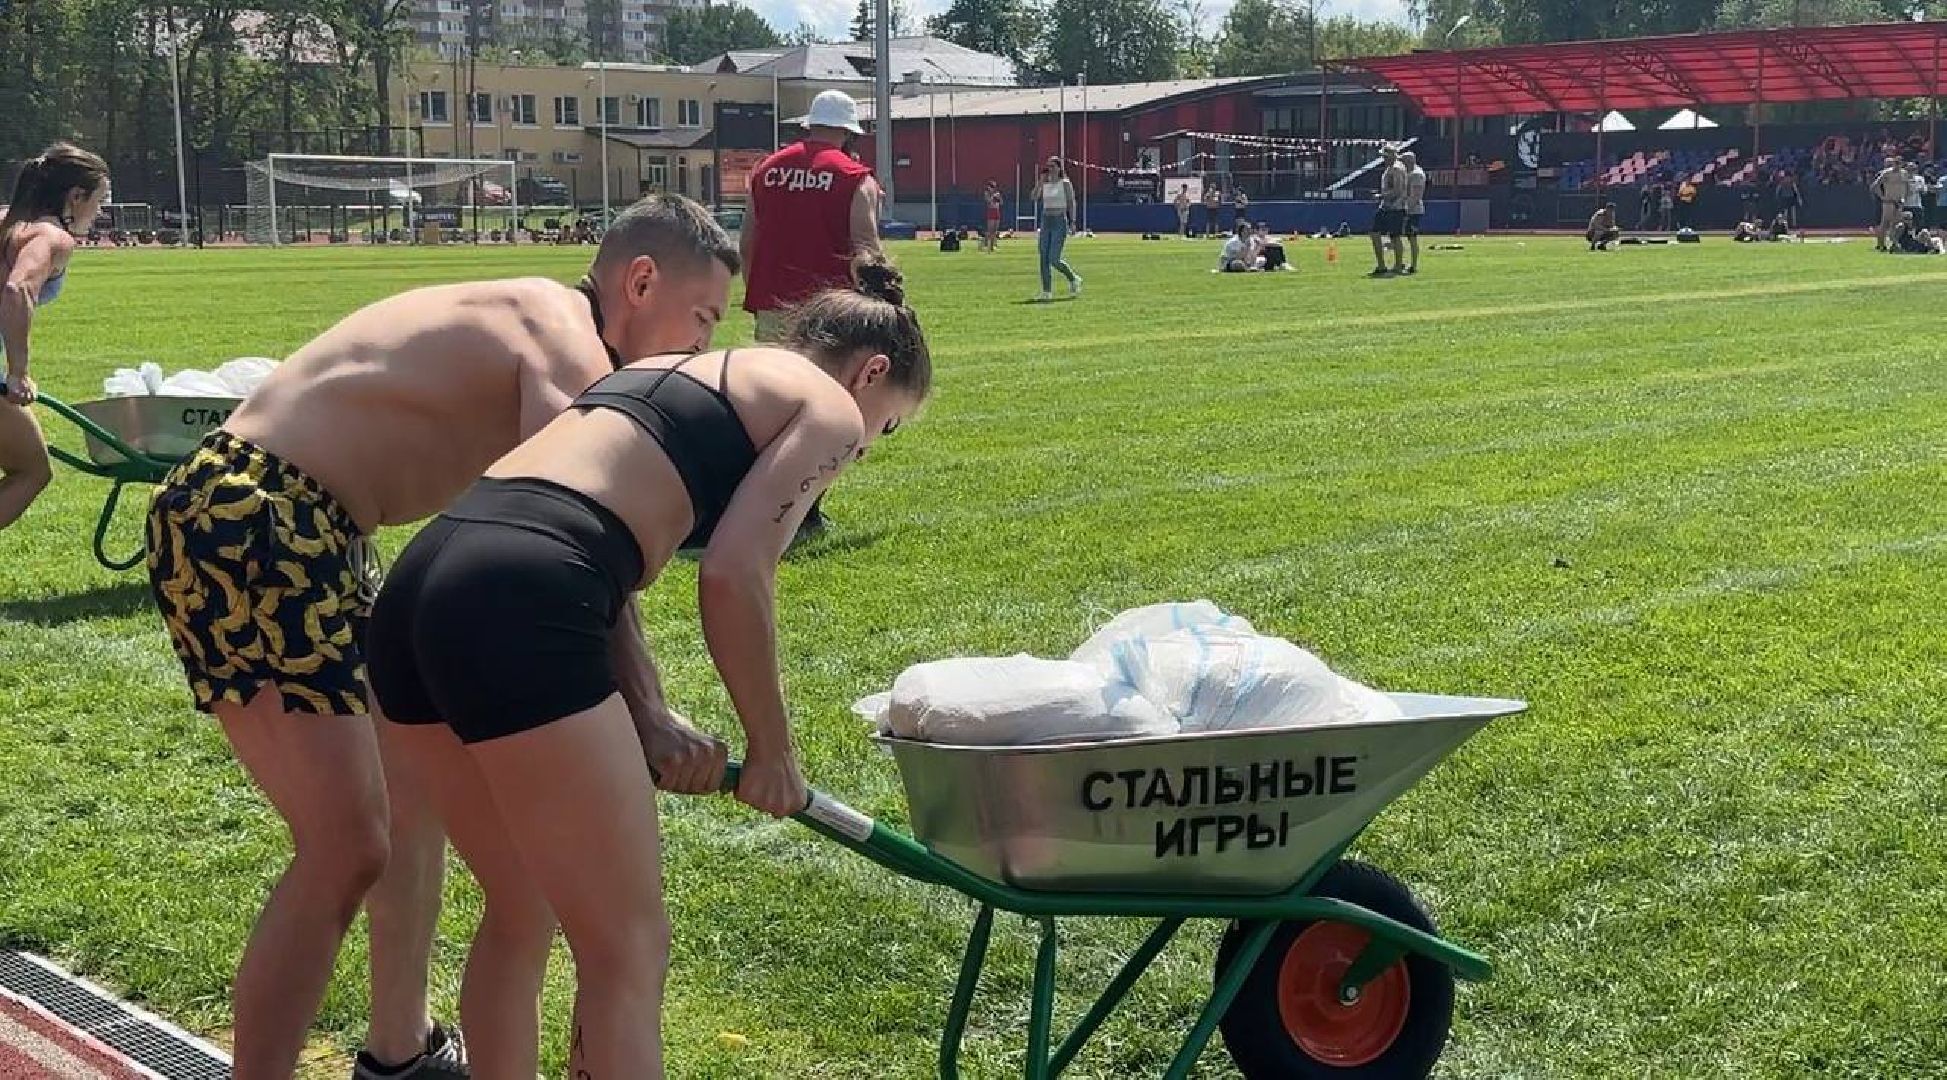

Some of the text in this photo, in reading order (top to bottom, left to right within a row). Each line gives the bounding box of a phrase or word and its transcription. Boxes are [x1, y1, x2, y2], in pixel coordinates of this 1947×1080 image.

[764, 167, 834, 192] СУДЬЯ
[1082, 756, 1358, 811] СТАЛЬНЫЕ
[1155, 811, 1289, 858] ИГРЫ
